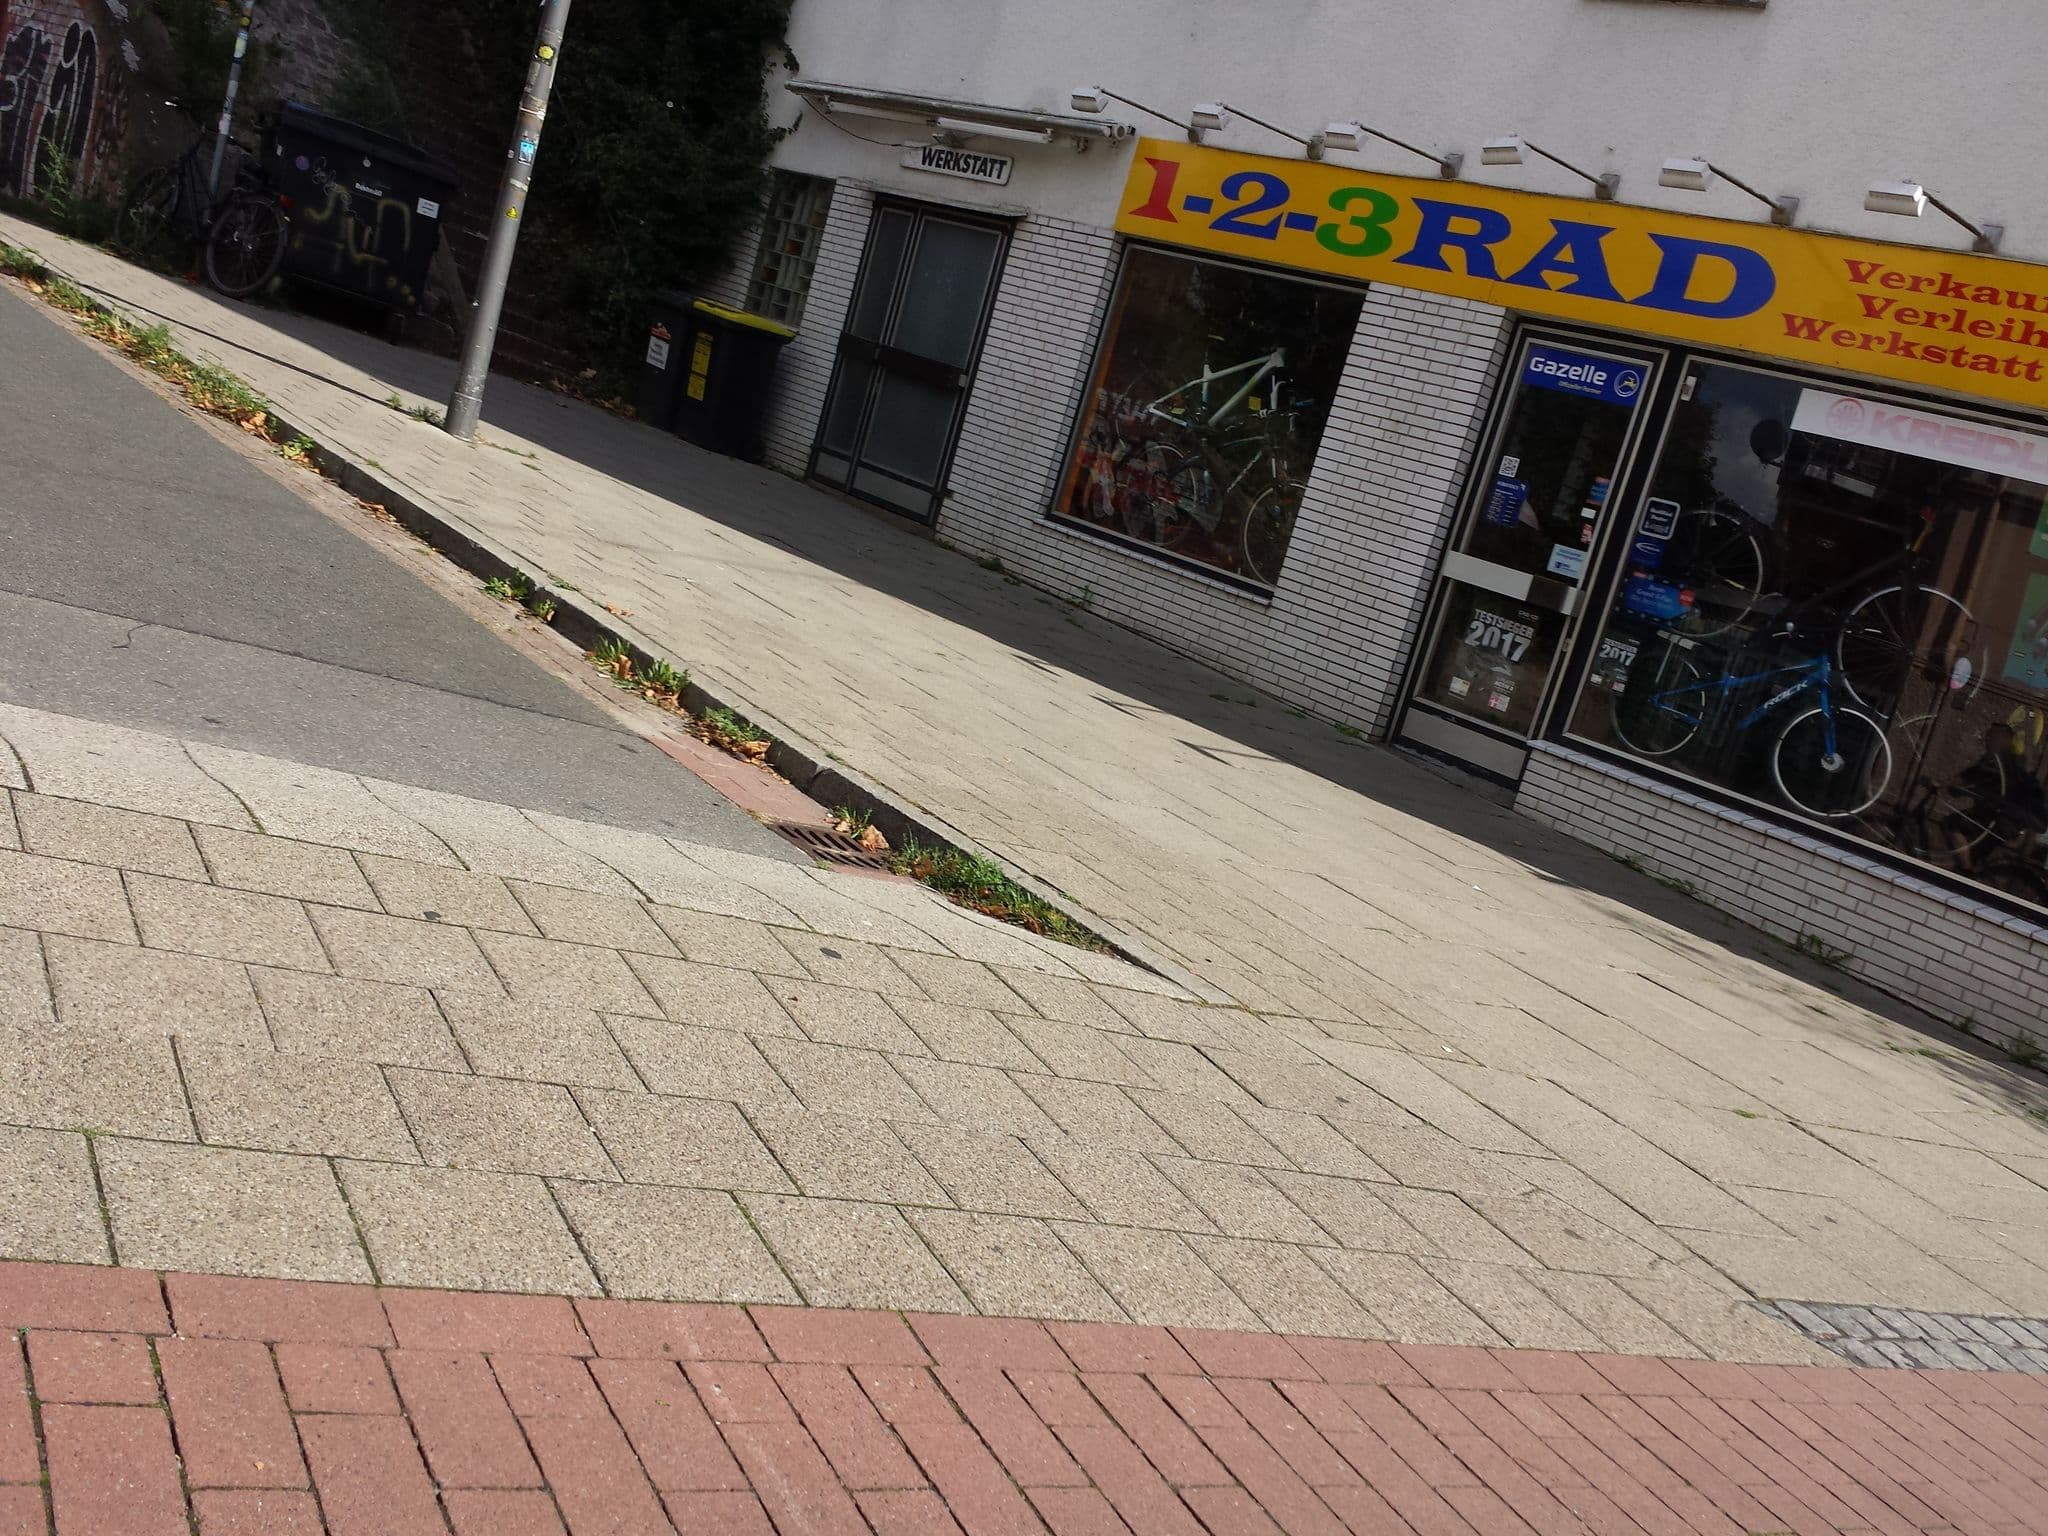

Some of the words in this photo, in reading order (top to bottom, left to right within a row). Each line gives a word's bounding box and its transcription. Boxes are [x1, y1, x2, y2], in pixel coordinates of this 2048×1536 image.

[921, 146, 1008, 180] WERKSTATT
[1856, 293, 2048, 349] Verleih
[1780, 312, 2044, 382] Werkstatt
[1529, 357, 1607, 386] Gazelle
[1869, 410, 2048, 472] KREIDL
[1464, 620, 1531, 662] 2017
[1473, 608, 1535, 639] TESTSIEGER
[1600, 645, 1636, 666] 2017
